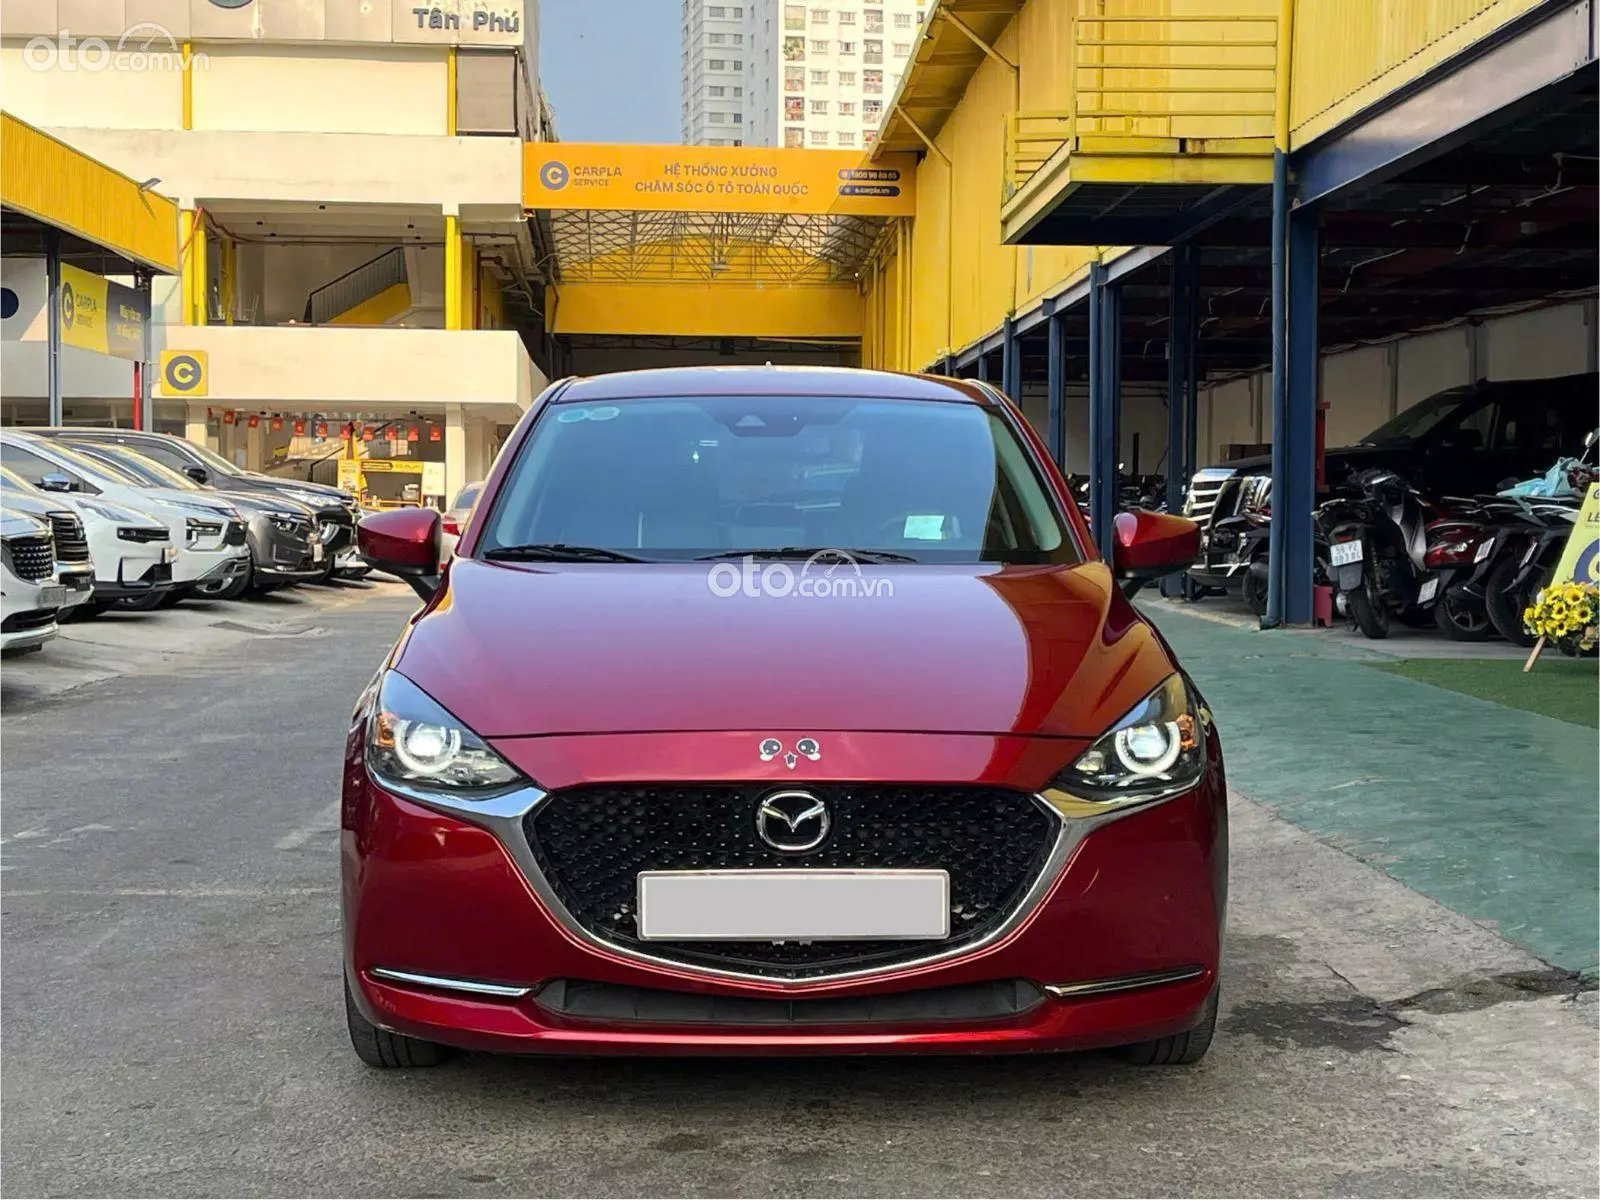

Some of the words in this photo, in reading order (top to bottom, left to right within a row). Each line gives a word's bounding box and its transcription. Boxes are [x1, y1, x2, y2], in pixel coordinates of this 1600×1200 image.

[412, 7, 460, 29] Tân
[472, 10, 520, 32] Phú
[573, 166, 623, 176] CARPLA
[664, 162, 681, 178] HỆ
[684, 162, 728, 177] THỐNG
[573, 178, 610, 187] SERVICE
[676, 180, 702, 193] SÓC
[706, 180, 715, 193] Ô
[718, 181, 734, 194] TÔ
[737, 181, 771, 195] TOÀN
[773, 180, 809, 196] QUỐC
